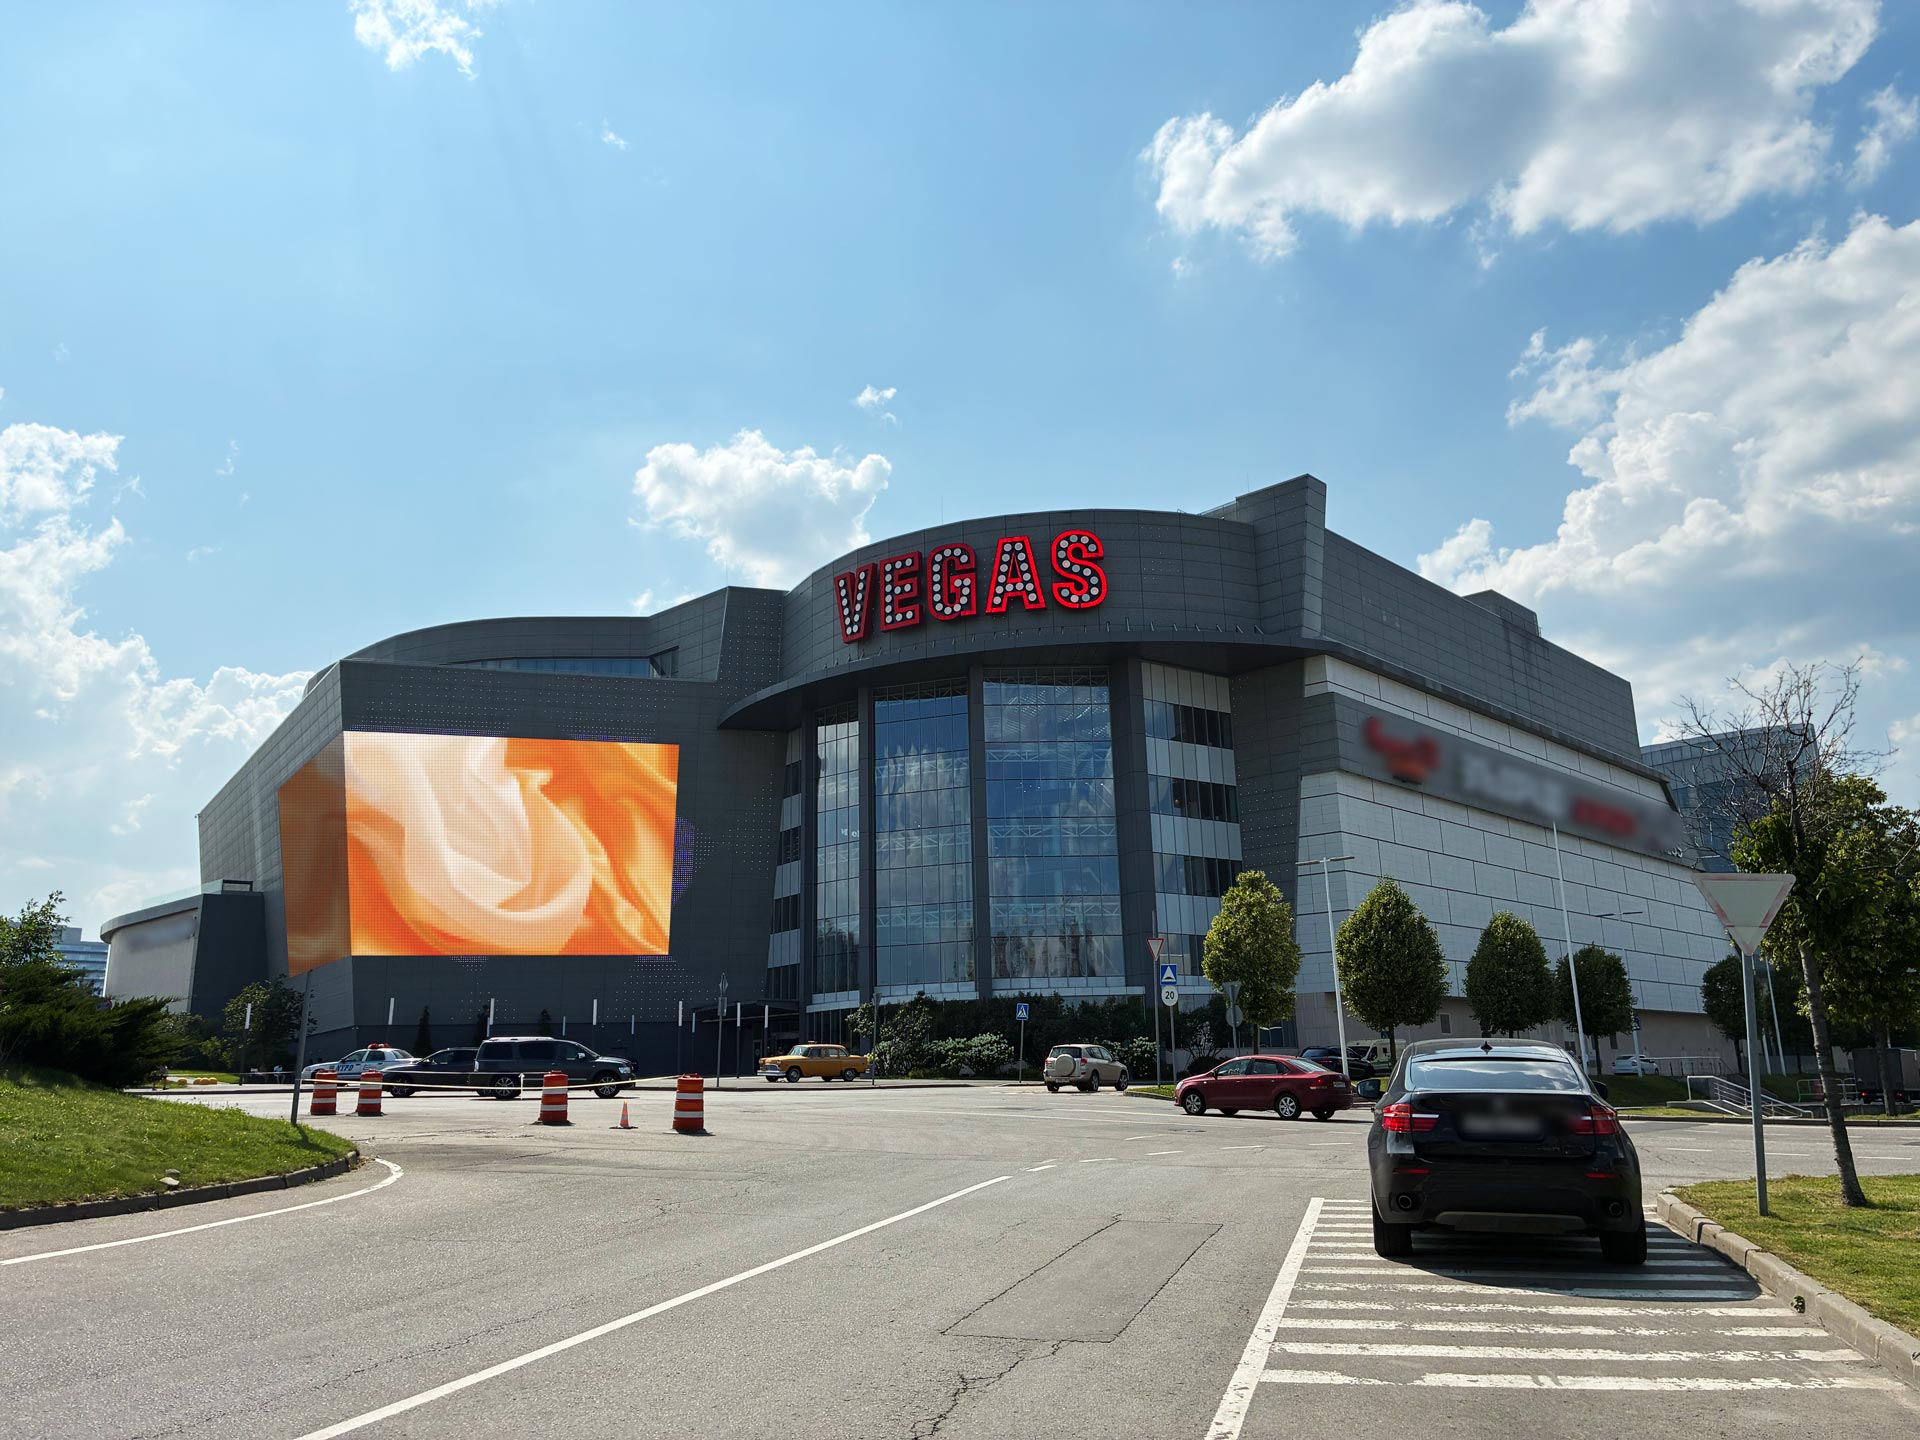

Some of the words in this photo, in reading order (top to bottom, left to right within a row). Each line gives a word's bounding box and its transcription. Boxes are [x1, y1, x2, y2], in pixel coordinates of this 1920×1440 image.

[834, 529, 1108, 643] VEGAS
[1165, 991, 1175, 1000] 20
[336, 1064, 354, 1072] NYPD
